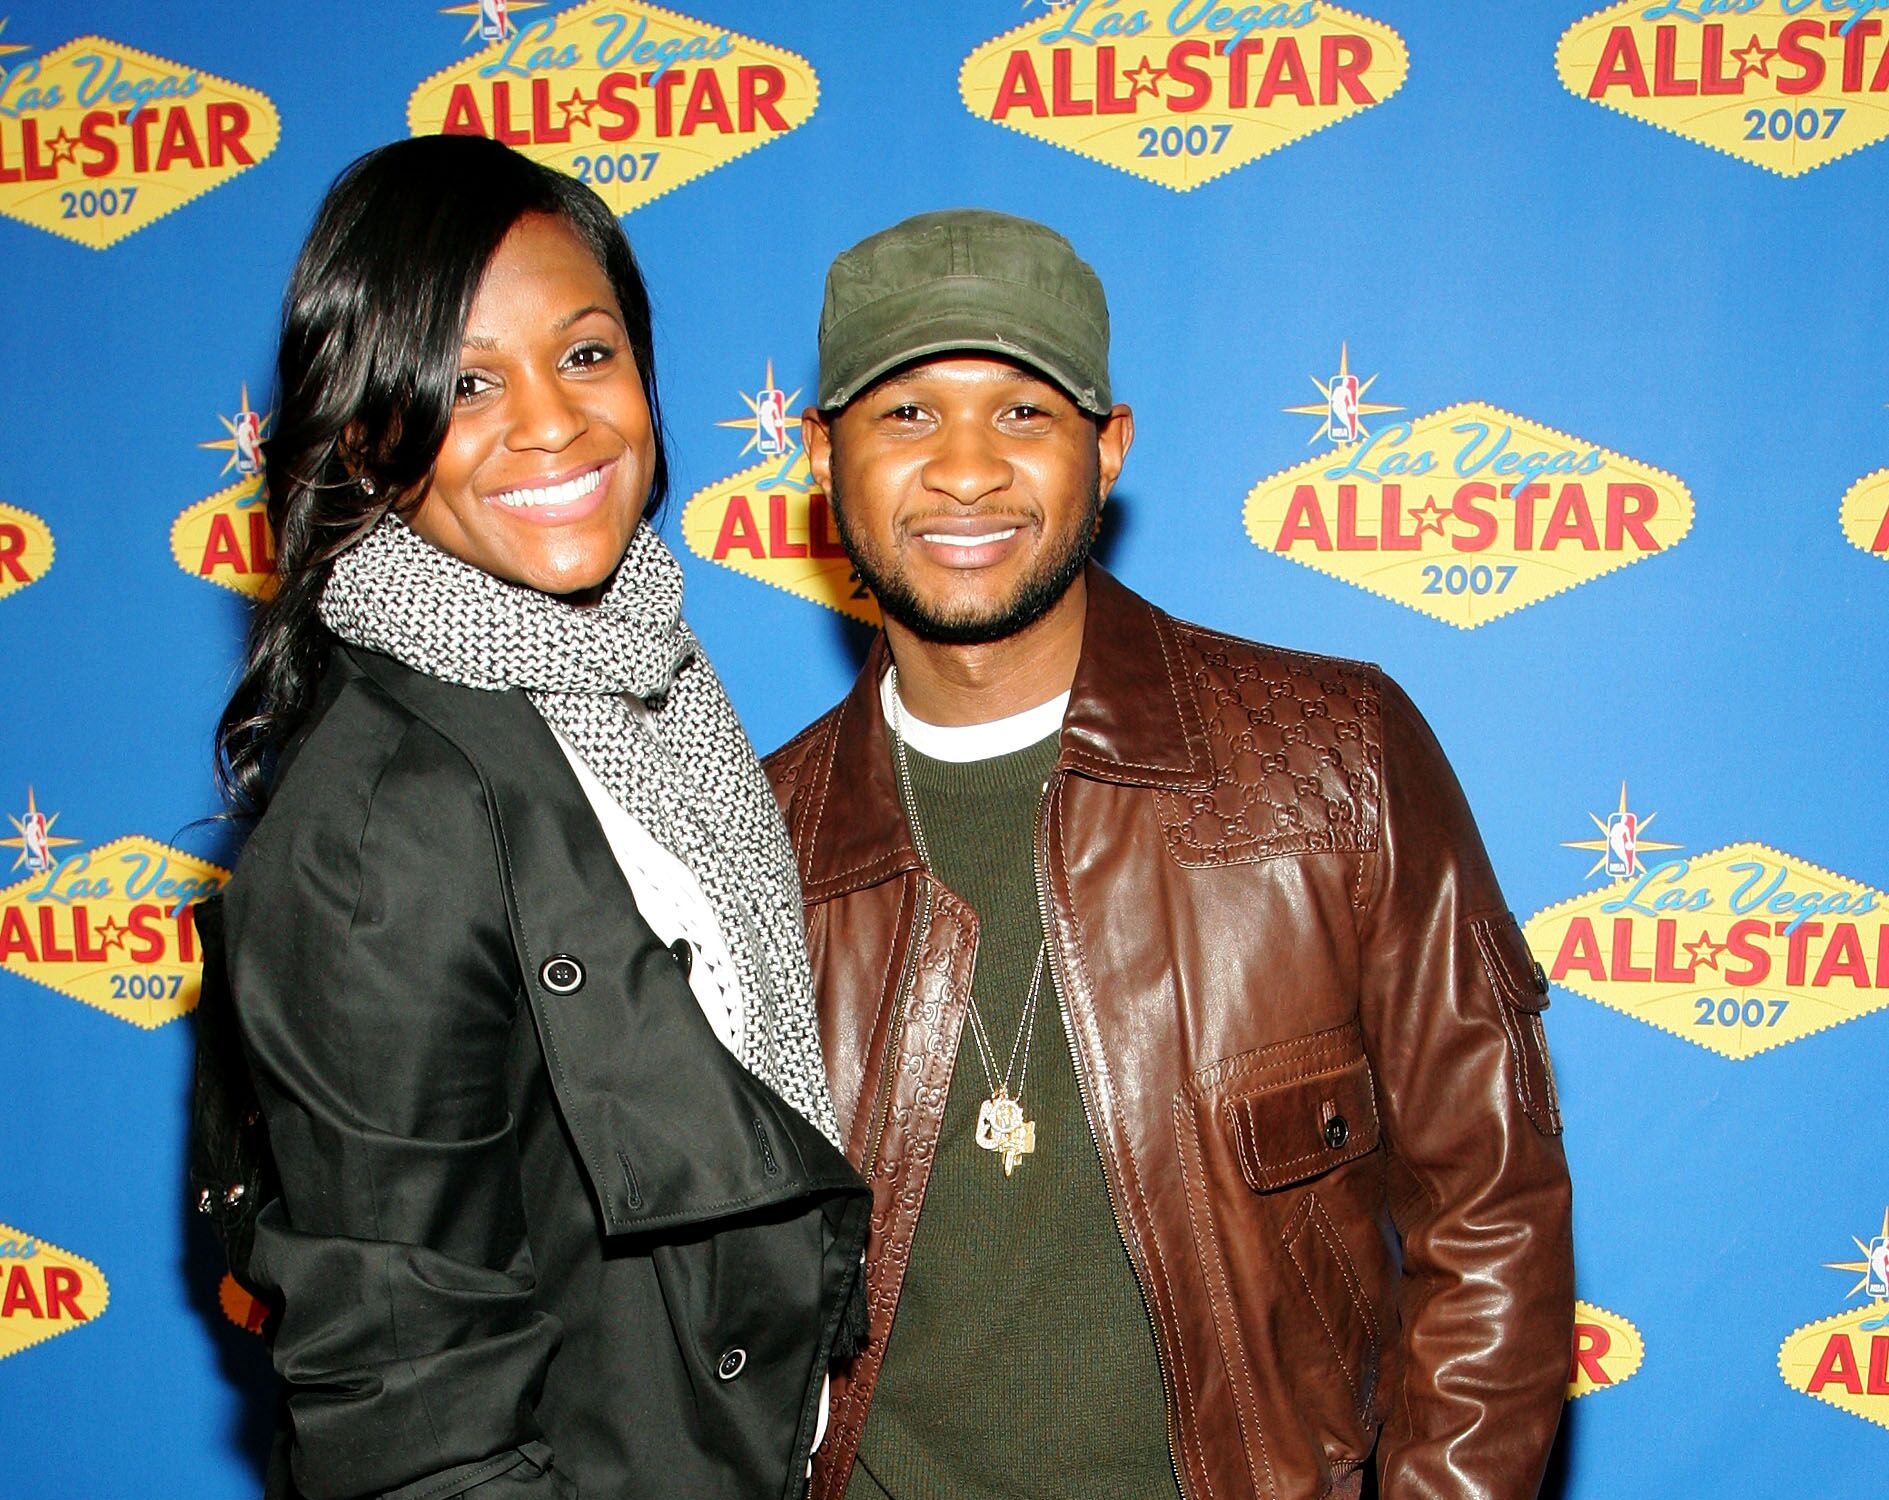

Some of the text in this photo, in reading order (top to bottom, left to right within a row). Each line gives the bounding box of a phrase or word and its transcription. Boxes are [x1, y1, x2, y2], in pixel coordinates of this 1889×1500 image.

[478, 13, 736, 87] Las Vegas
[991, 34, 1378, 120] ALL STAR
[1587, 23, 1744, 97] ALL
[72, 55, 204, 124] Vegas
[442, 64, 792, 146] ALL STAR
[80, 102, 256, 178] STAR
[1137, 124, 1232, 158] 2007
[1743, 108, 1847, 141] 2007
[571, 152, 660, 184] 2007
[60, 187, 138, 219] 2007
[1323, 421, 1606, 498] Las Vegas
[201, 512, 277, 575] AL
[1274, 482, 1661, 553] ALL STAR
[1422, 565, 1519, 596] 2007
[27, 853, 113, 905] Las
[1601, 860, 1880, 937] Las Vegas
[0, 903, 203, 964] ALL ST
[1549, 917, 1889, 989] ALL STA
[109, 974, 183, 999] 2007
[1693, 997, 1790, 1028] 2007
